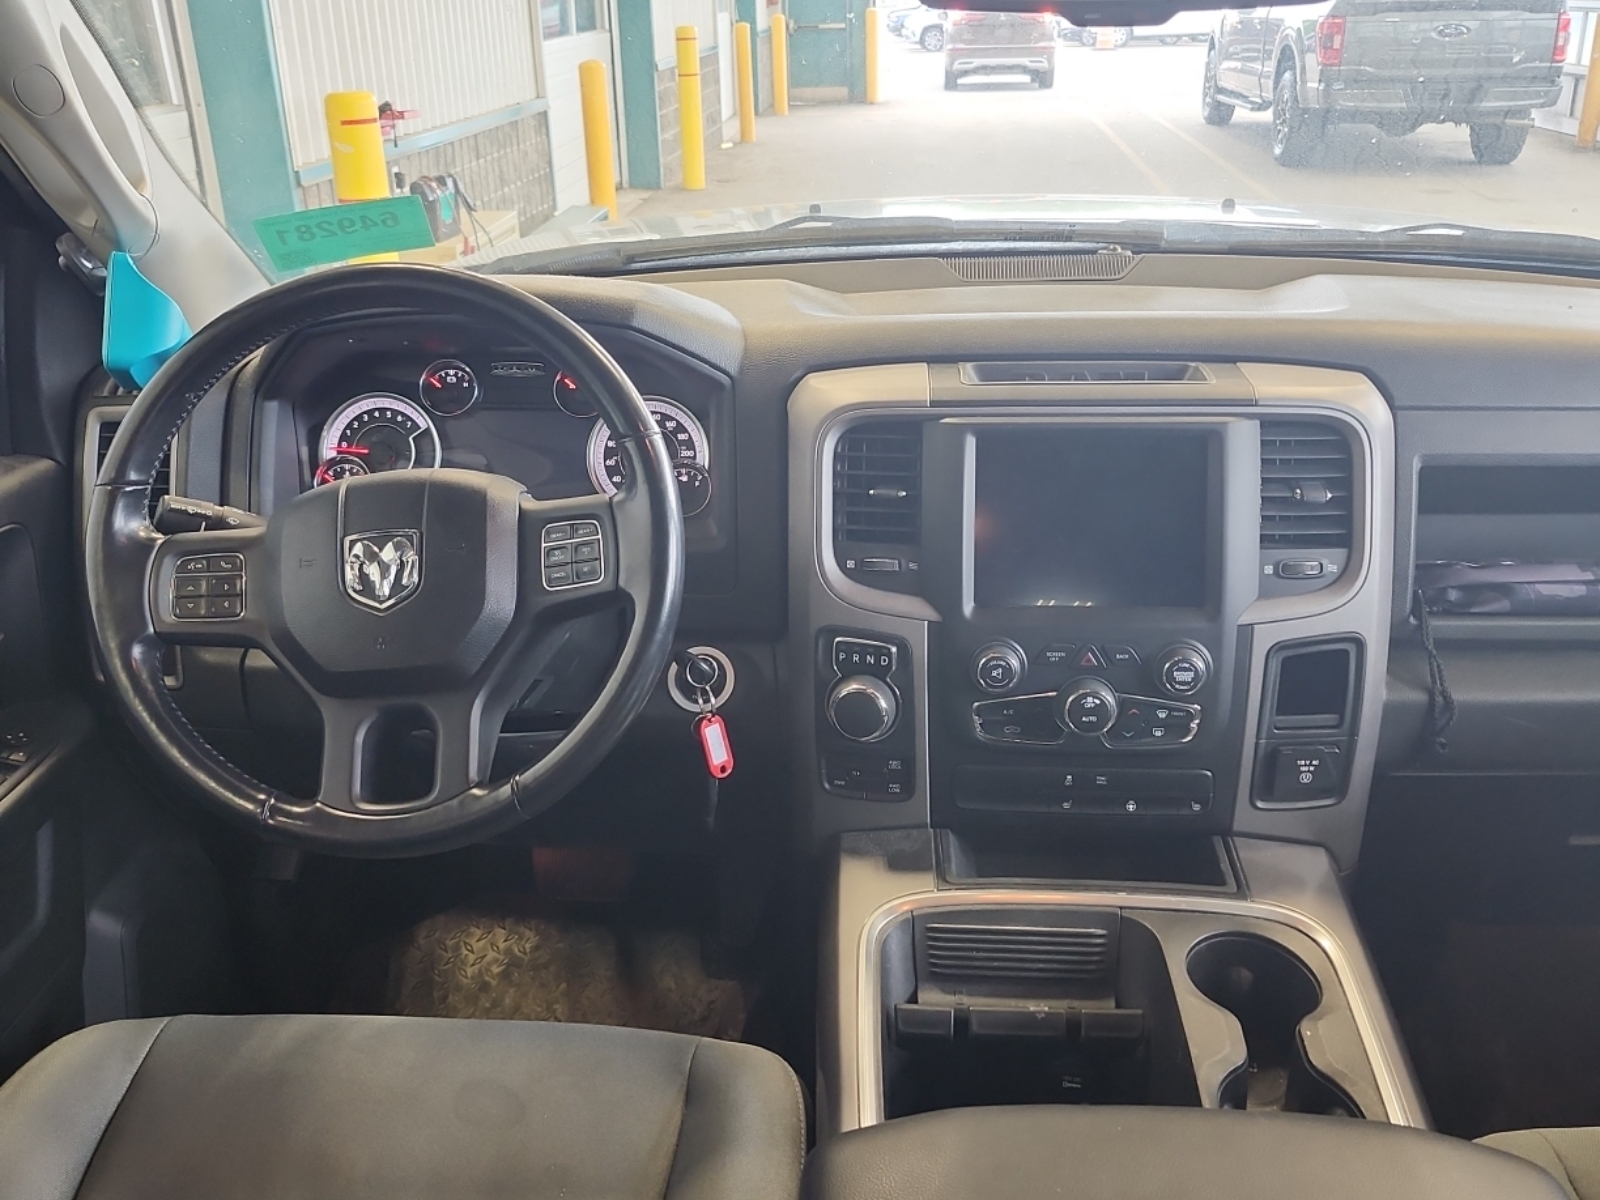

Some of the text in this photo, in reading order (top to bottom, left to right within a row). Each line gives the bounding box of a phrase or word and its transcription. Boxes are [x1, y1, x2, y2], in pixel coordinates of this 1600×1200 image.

[839, 652, 889, 666] P R N D
